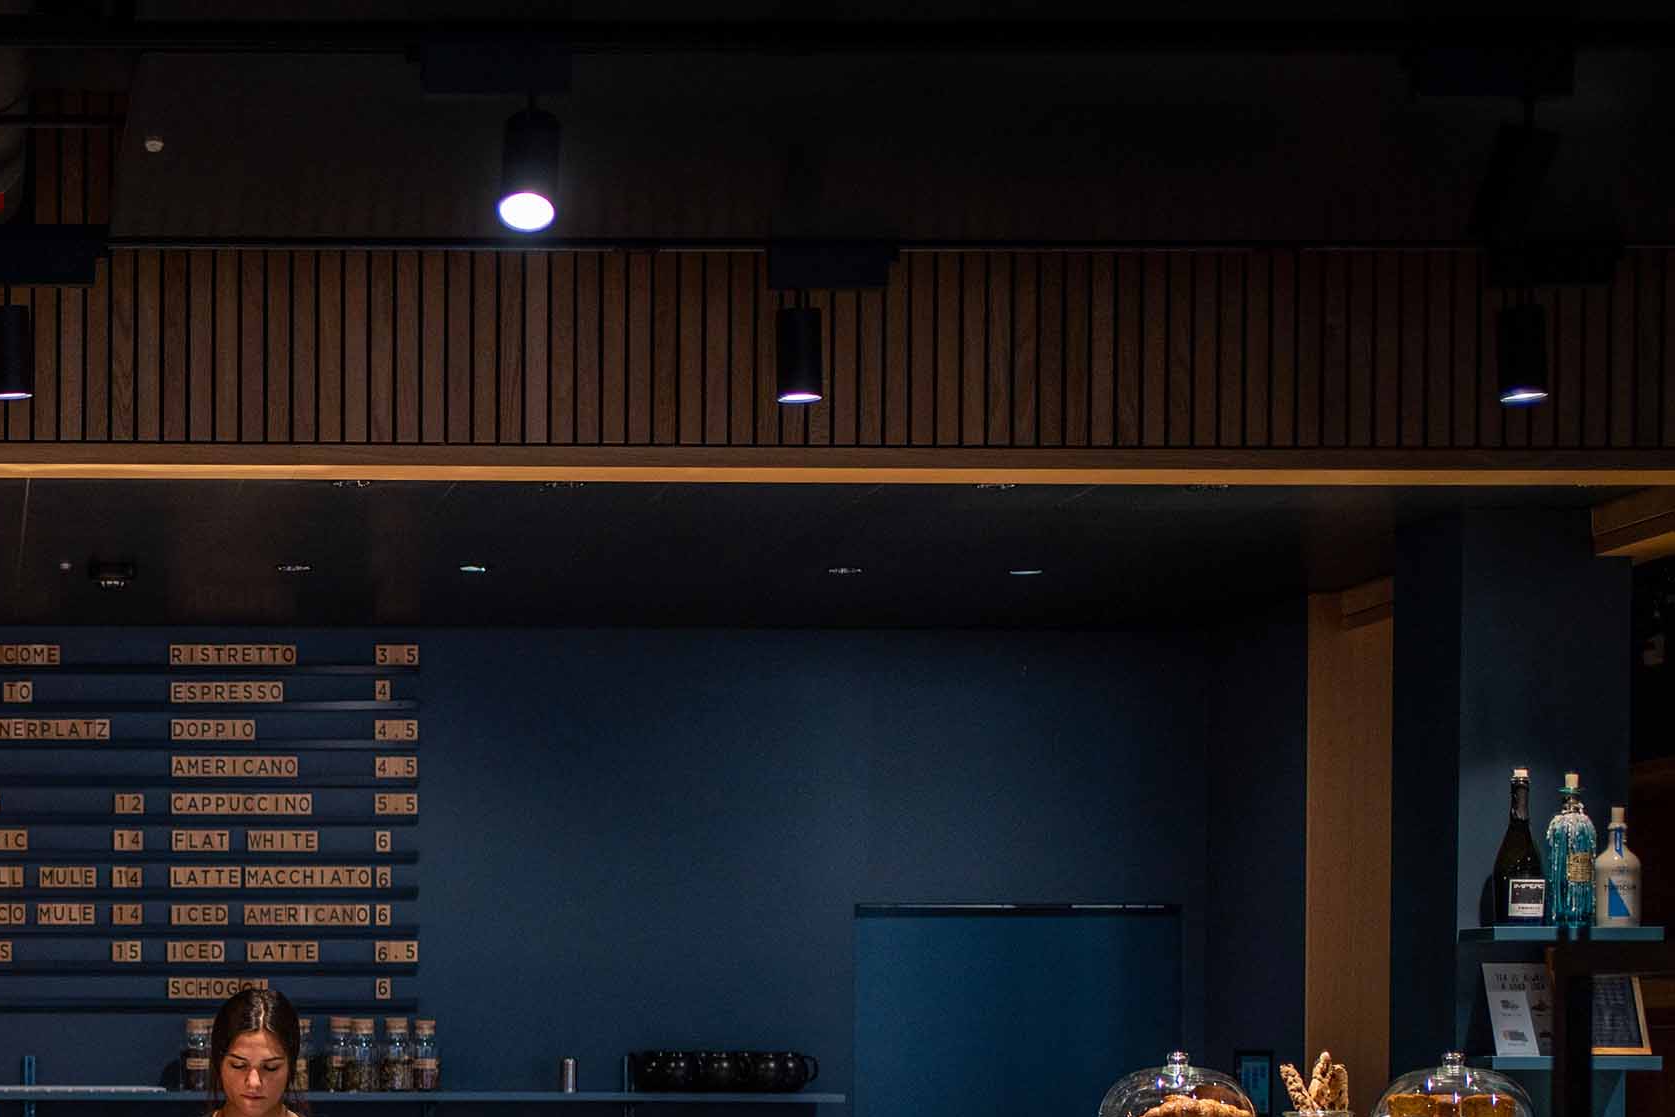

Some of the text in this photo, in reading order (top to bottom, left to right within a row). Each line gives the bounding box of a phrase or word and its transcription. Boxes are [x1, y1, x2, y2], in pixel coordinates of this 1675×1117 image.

[172, 648, 416, 662] RISTRETTO 3.5
[6, 686, 30, 699] TO
[173, 684, 387, 699] ESPRESSO 4
[173, 723, 415, 737] DOPPIO 4.5
[174, 760, 415, 775] AMERICANO 4.5
[119, 797, 140, 811] 12
[173, 797, 415, 811] CAPPUCCINO 5.5
[119, 834, 140, 847] 14
[175, 834, 387, 848] FLAT WHITE 6
[42, 871, 93, 885] MULE
[118, 871, 138, 885] 14
[173, 870, 388, 887] LATTE MACCHIATO 6
[40, 908, 92, 922] MULE
[118, 908, 138, 921] 14
[176, 908, 387, 922] ICED AMERICANO 6
[118, 945, 138, 959] 15
[172, 944, 414, 960] ICED LATTE 6.5
[379, 982, 387, 996] 6
